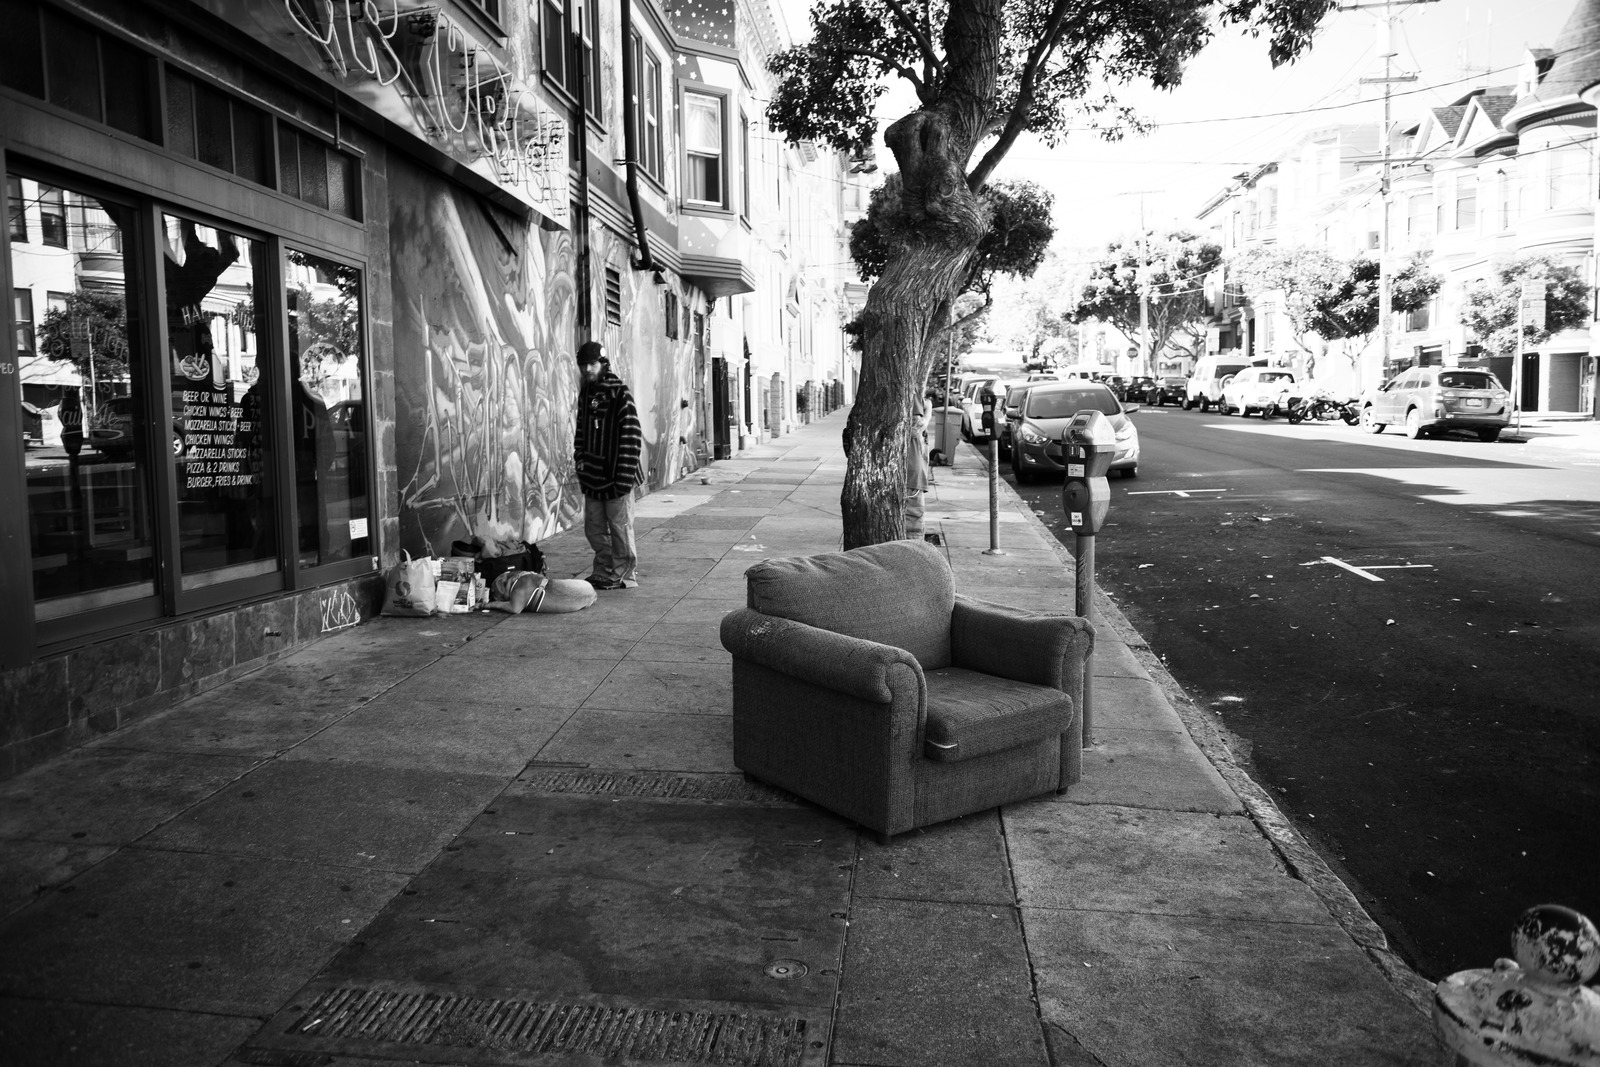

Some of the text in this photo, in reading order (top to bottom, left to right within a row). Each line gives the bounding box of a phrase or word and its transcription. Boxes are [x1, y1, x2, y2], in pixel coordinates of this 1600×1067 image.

[0, 362, 15, 375] ED
[183, 390, 199, 402] BEER
[201, 391, 210, 403] OR
[212, 393, 228, 404] WINE
[184, 405, 207, 417] CHICKEN
[209, 406, 227, 418] WINGS
[184, 419, 217, 431] MOZZARELLA
[218, 420, 237, 432] STICKS
[240, 421, 252, 432] BEER
[185, 434, 212, 446] CHICKEN
[214, 434, 234, 445] WINGS
[186, 448, 226, 459] MOZZARELLA
[227, 448, 246, 459] STICKS
[186, 462, 205, 474] PIZZA
[207, 462, 212, 474] &
[213, 462, 218, 473] 2
[218, 461, 240, 473] DRINKS
[231, 475, 237, 486] &
